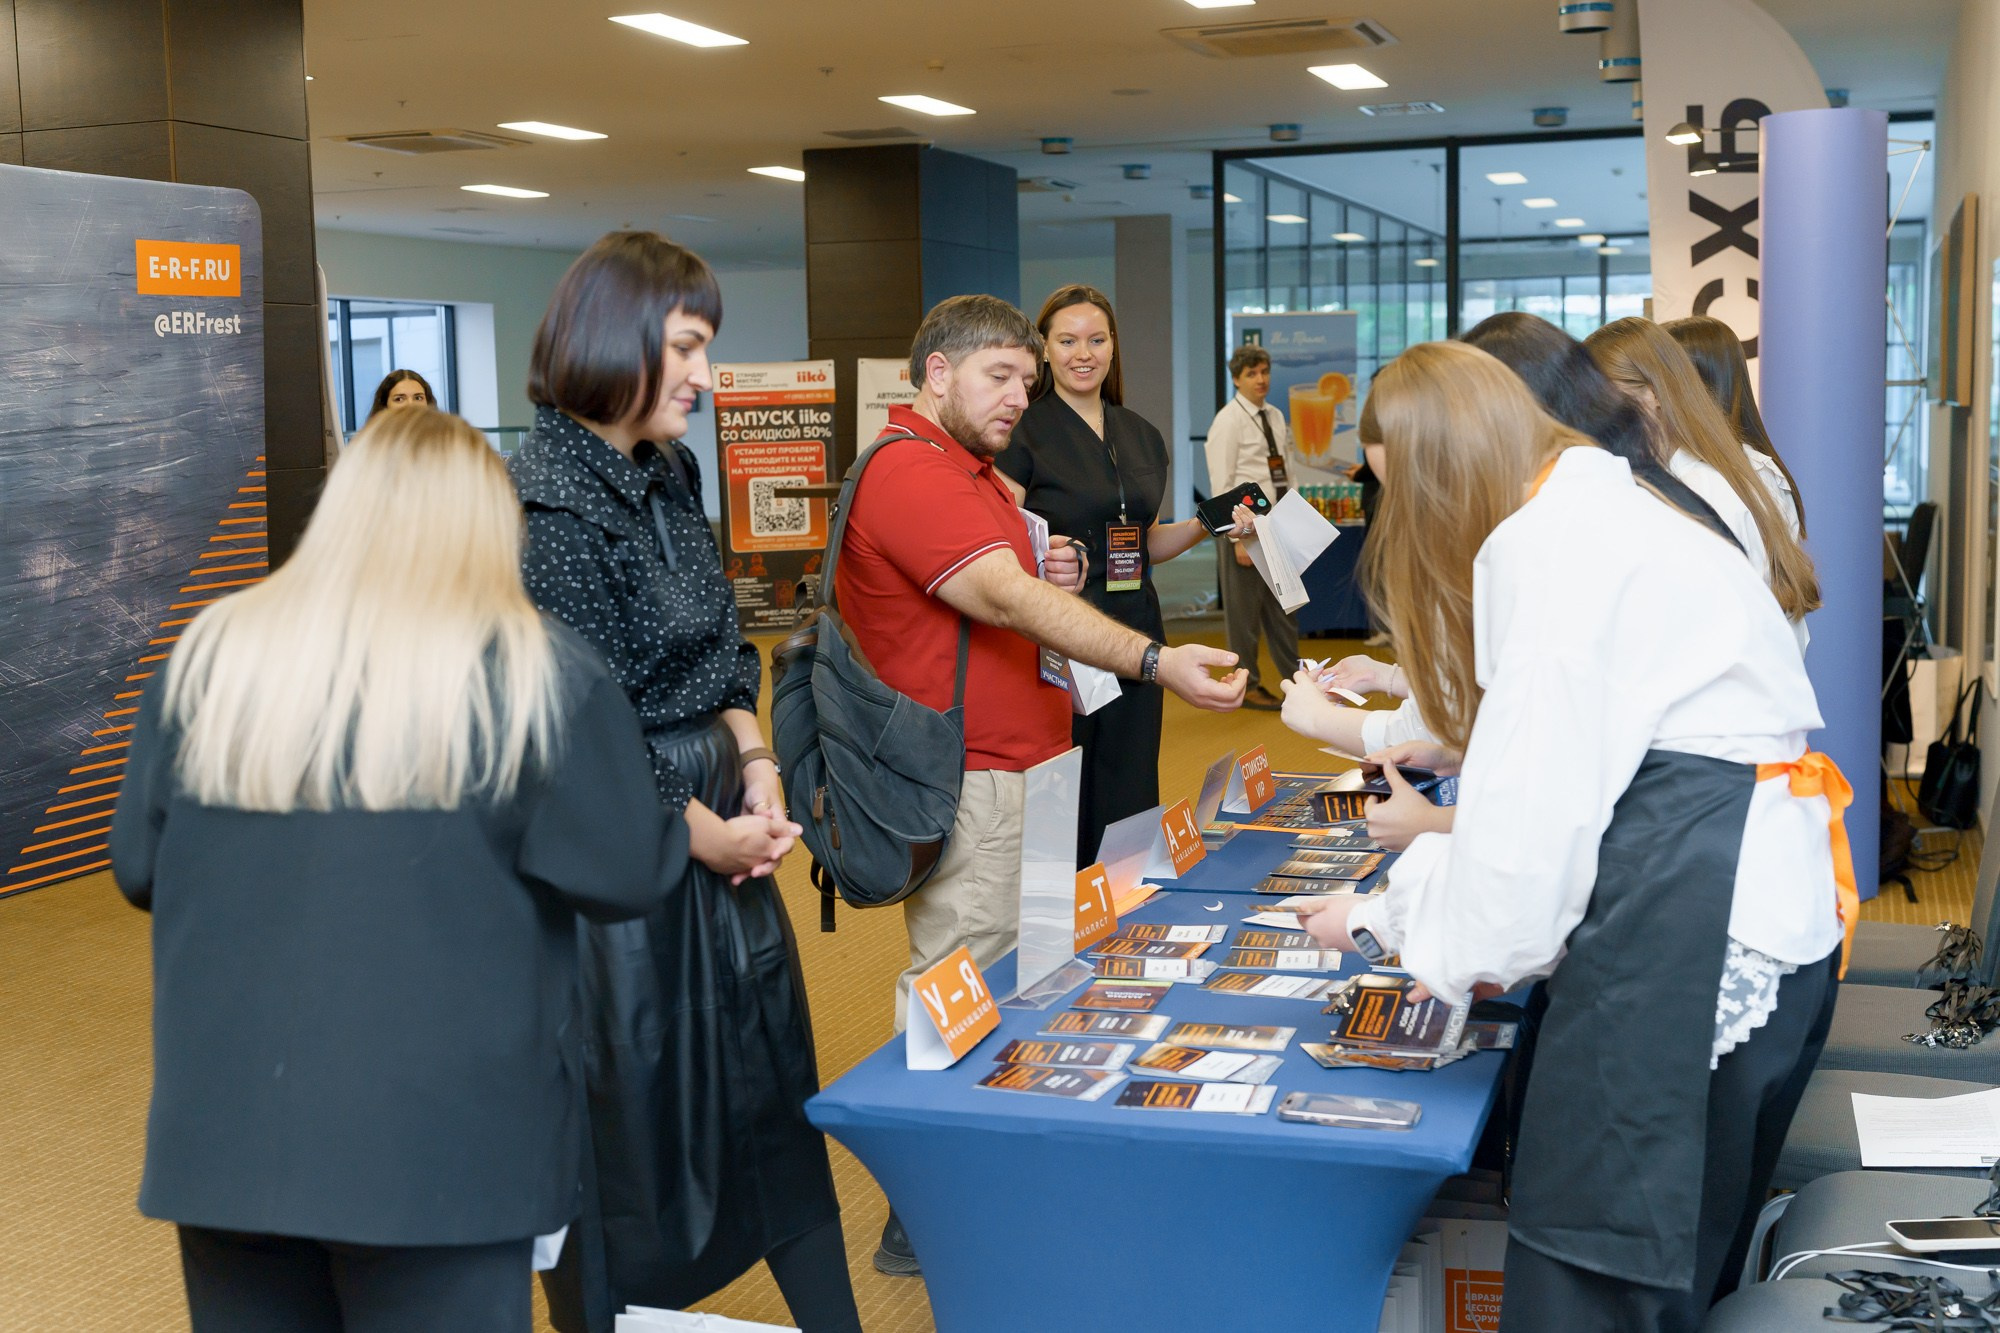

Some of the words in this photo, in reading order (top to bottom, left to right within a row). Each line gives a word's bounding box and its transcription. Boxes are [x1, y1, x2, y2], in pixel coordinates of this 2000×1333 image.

[149, 256, 230, 281] E-R-F.RU
[154, 311, 241, 338] @ERFrest
[797, 369, 827, 383] iiko
[720, 410, 796, 428] ЗАПУСК
[799, 409, 832, 425] iiko
[720, 430, 739, 441] СО
[741, 425, 801, 442] СКИДКОЙ
[803, 426, 832, 439] 50%
[734, 447, 765, 456] УСТАЛИ
[766, 447, 777, 455] ОТ
[739, 456, 789, 465] ПЕРЕХОДИТЕ
[790, 456, 797, 464] К
[797, 455, 816, 463] НАМ
[731, 467, 744, 475] НА
[1042, 669, 1069, 689] УЧАСТНИК
[1241, 752, 1269, 780] СПИКЕРЫ
[1255, 780, 1265, 799] VIP
